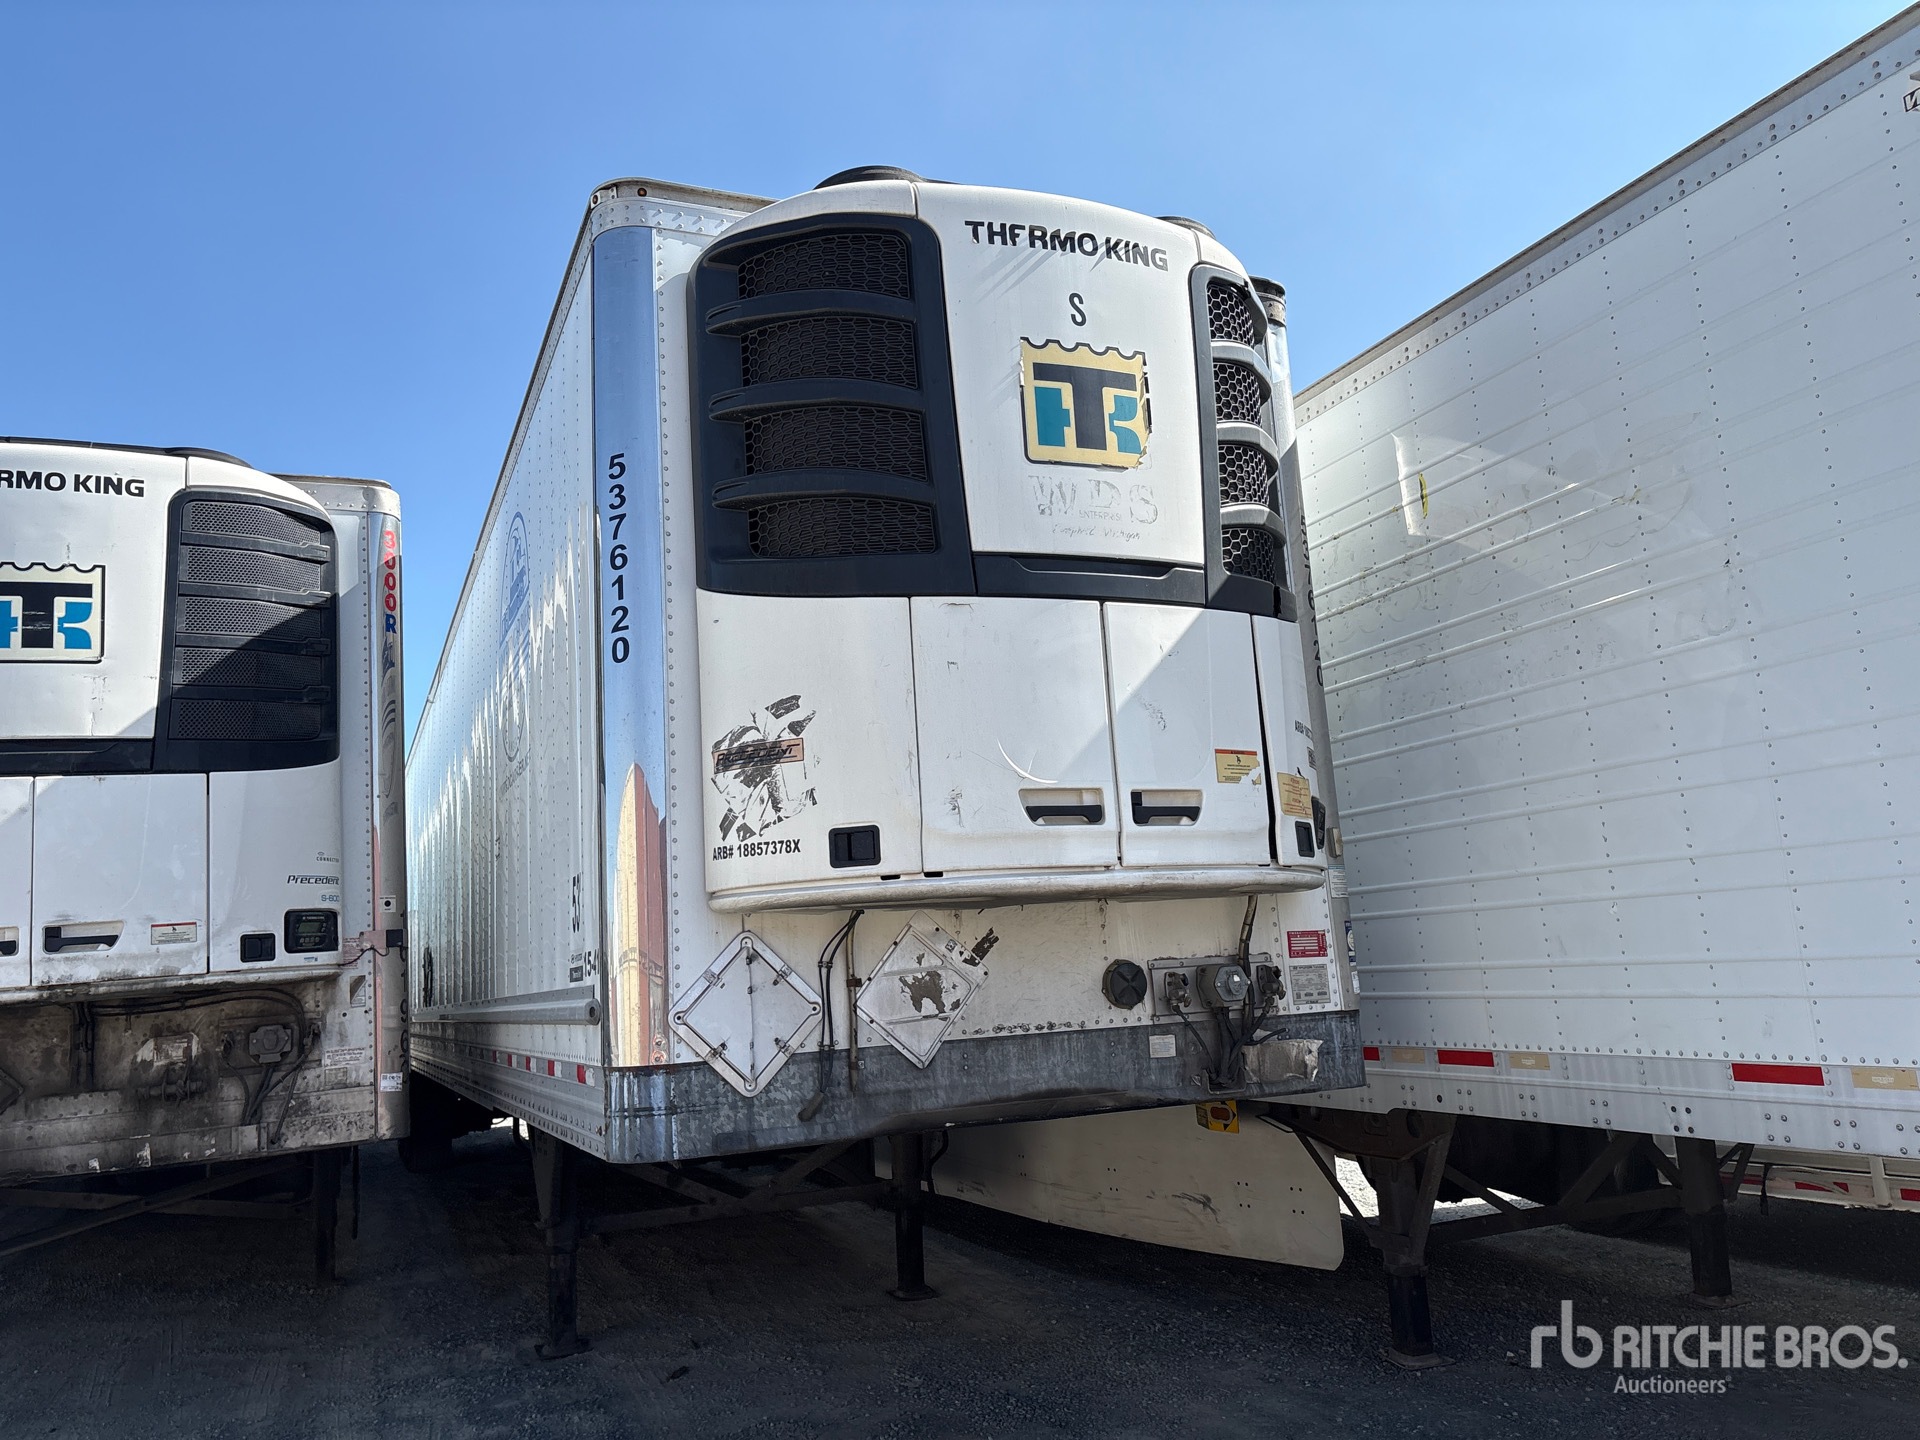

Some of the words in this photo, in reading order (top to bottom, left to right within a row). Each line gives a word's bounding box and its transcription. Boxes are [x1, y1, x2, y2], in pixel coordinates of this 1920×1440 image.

[1105, 236, 1169, 272] KING
[1068, 292, 1087, 326] S
[73, 473, 145, 498] KING
[608, 452, 630, 664] 5376120
[712, 844, 735, 861] ARB#
[736, 838, 801, 858] 18857378X
